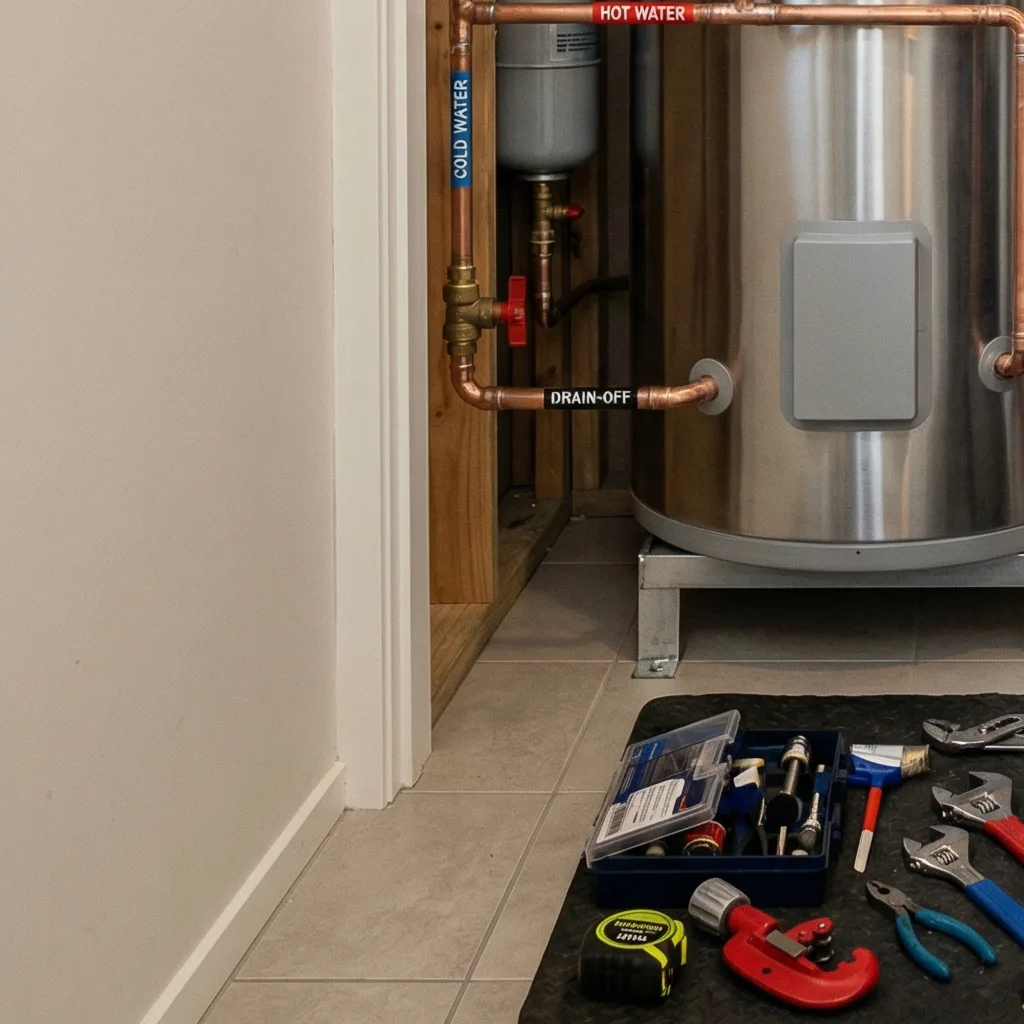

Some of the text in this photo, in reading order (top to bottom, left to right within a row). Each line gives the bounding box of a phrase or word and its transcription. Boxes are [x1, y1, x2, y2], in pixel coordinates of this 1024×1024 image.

[600, 5, 685, 21] HOT WATER
[453, 79, 468, 179] COLD WATER
[551, 390, 631, 405] DRAIN-OFF
